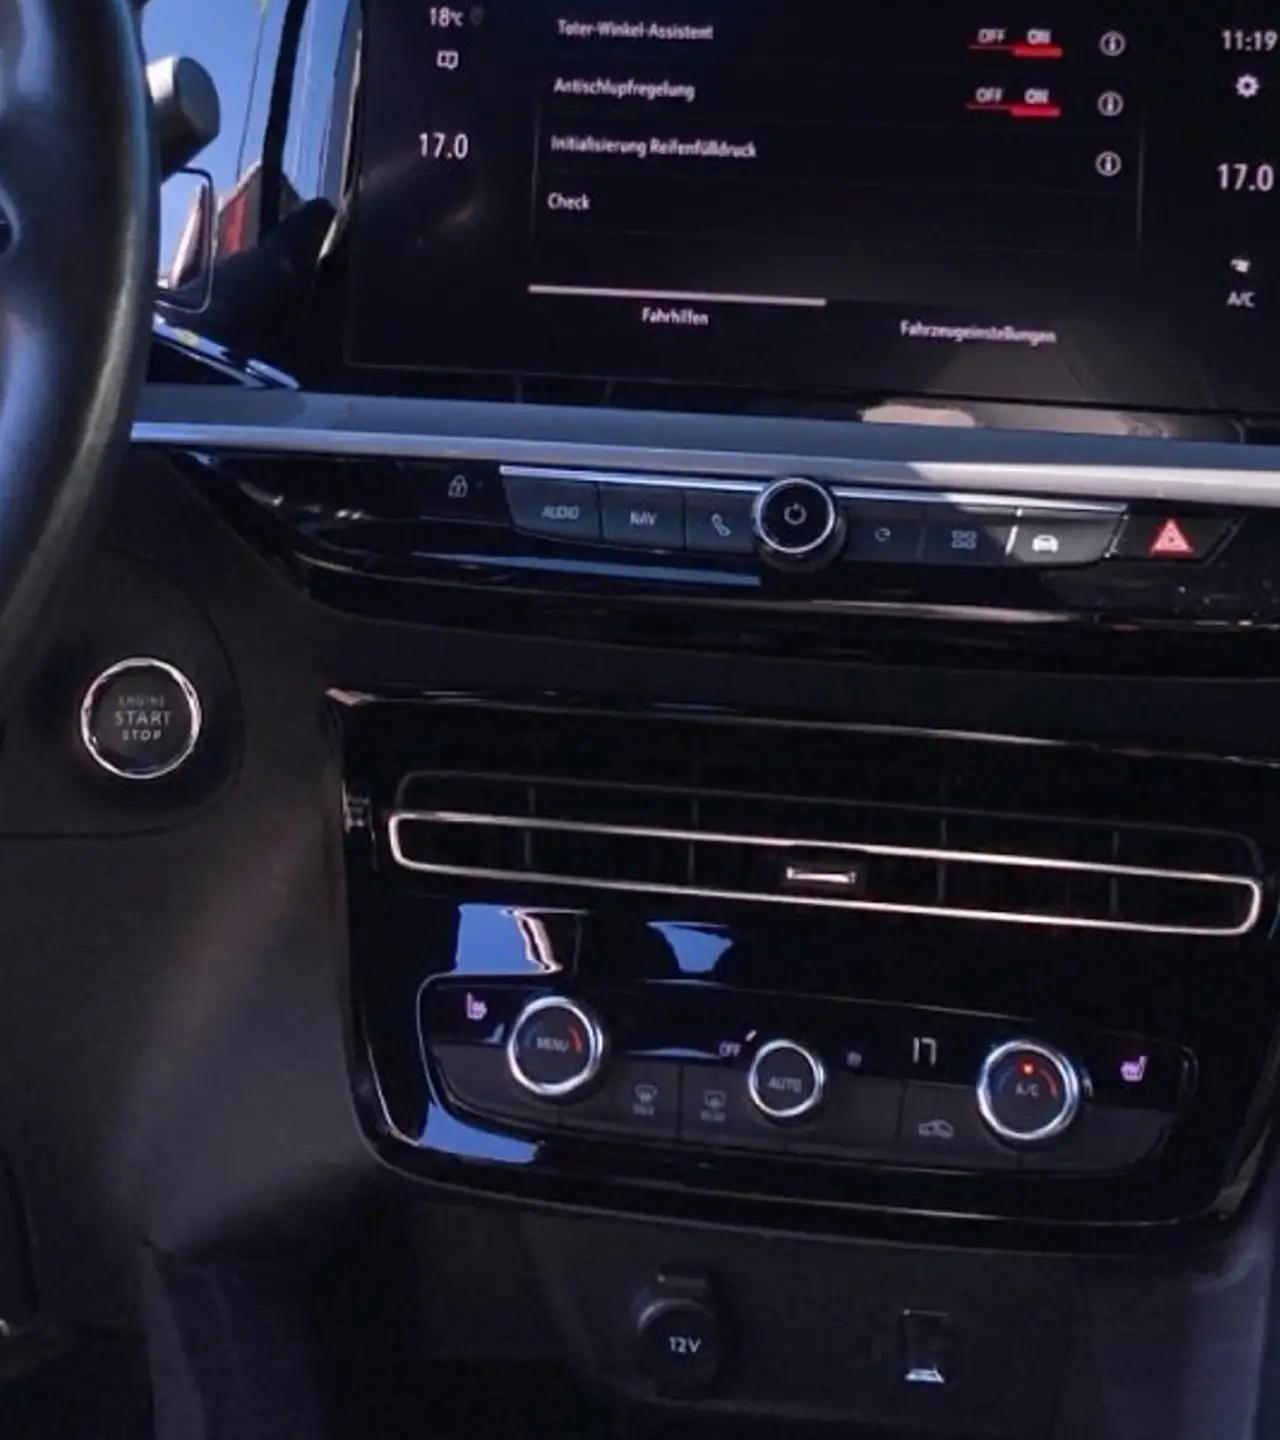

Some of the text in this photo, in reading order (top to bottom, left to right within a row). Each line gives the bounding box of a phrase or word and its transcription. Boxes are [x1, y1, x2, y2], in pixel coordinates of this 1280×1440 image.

[558, 19, 714, 40] Toter-Winkel-Assistent
[977, 29, 1007, 44] OFF
[1222, 30, 1278, 52] 11:19
[554, 78, 696, 102] Antischlupfregelung
[975, 88, 1004, 103] OFF
[419, 133, 469, 160] 17.0
[551, 135, 647, 158] Initialisierung
[1218, 163, 1274, 192] 17.0
[547, 193, 590, 210] Check
[1227, 292, 1255, 307] A/C
[642, 306, 709, 326] Fahrhilfen
[900, 318, 1056, 346] Fahrzeugeinstellungen
[541, 504, 580, 521] AUDIO
[630, 510, 655, 526] NAV
[115, 710, 172, 728] START
[536, 1036, 569, 1052] MENU
[720, 1041, 741, 1057] OFF
[768, 1076, 803, 1093] AUTO
[669, 1337, 702, 1354] 12V
